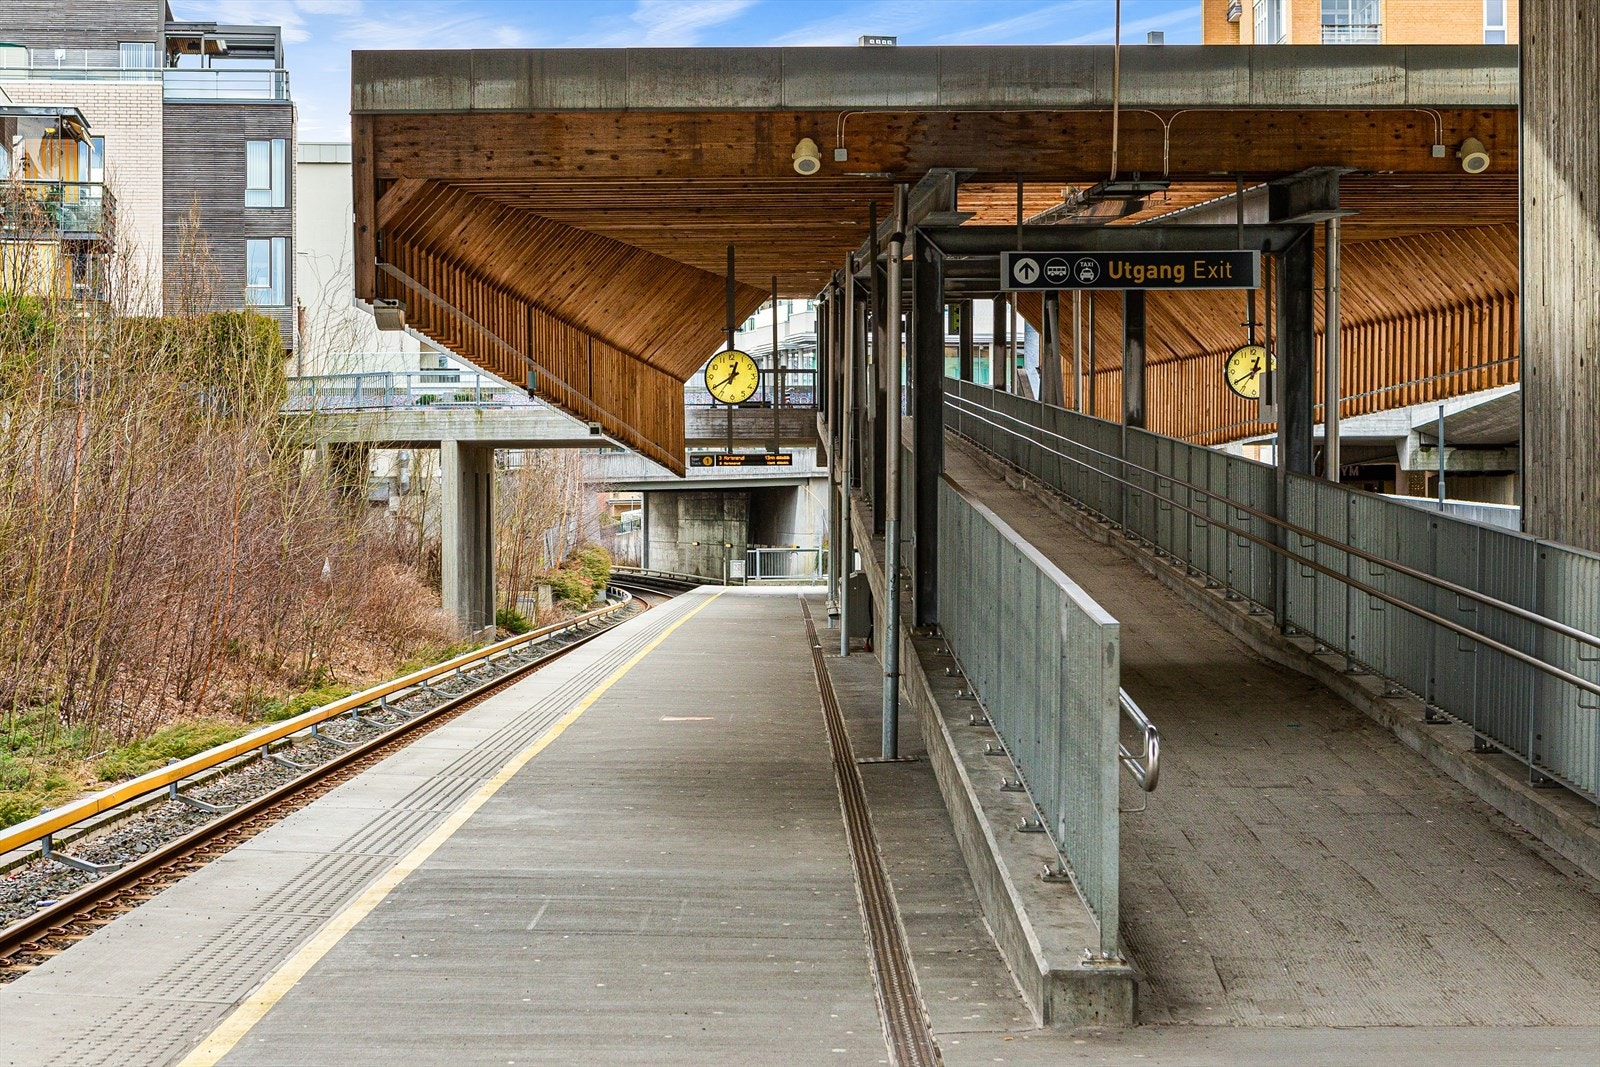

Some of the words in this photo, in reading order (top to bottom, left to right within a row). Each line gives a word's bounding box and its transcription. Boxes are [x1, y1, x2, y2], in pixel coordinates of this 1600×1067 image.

[1108, 260, 1185, 283] Utgang
[1194, 260, 1232, 279] Exit
[1341, 466, 1359, 477] YM
